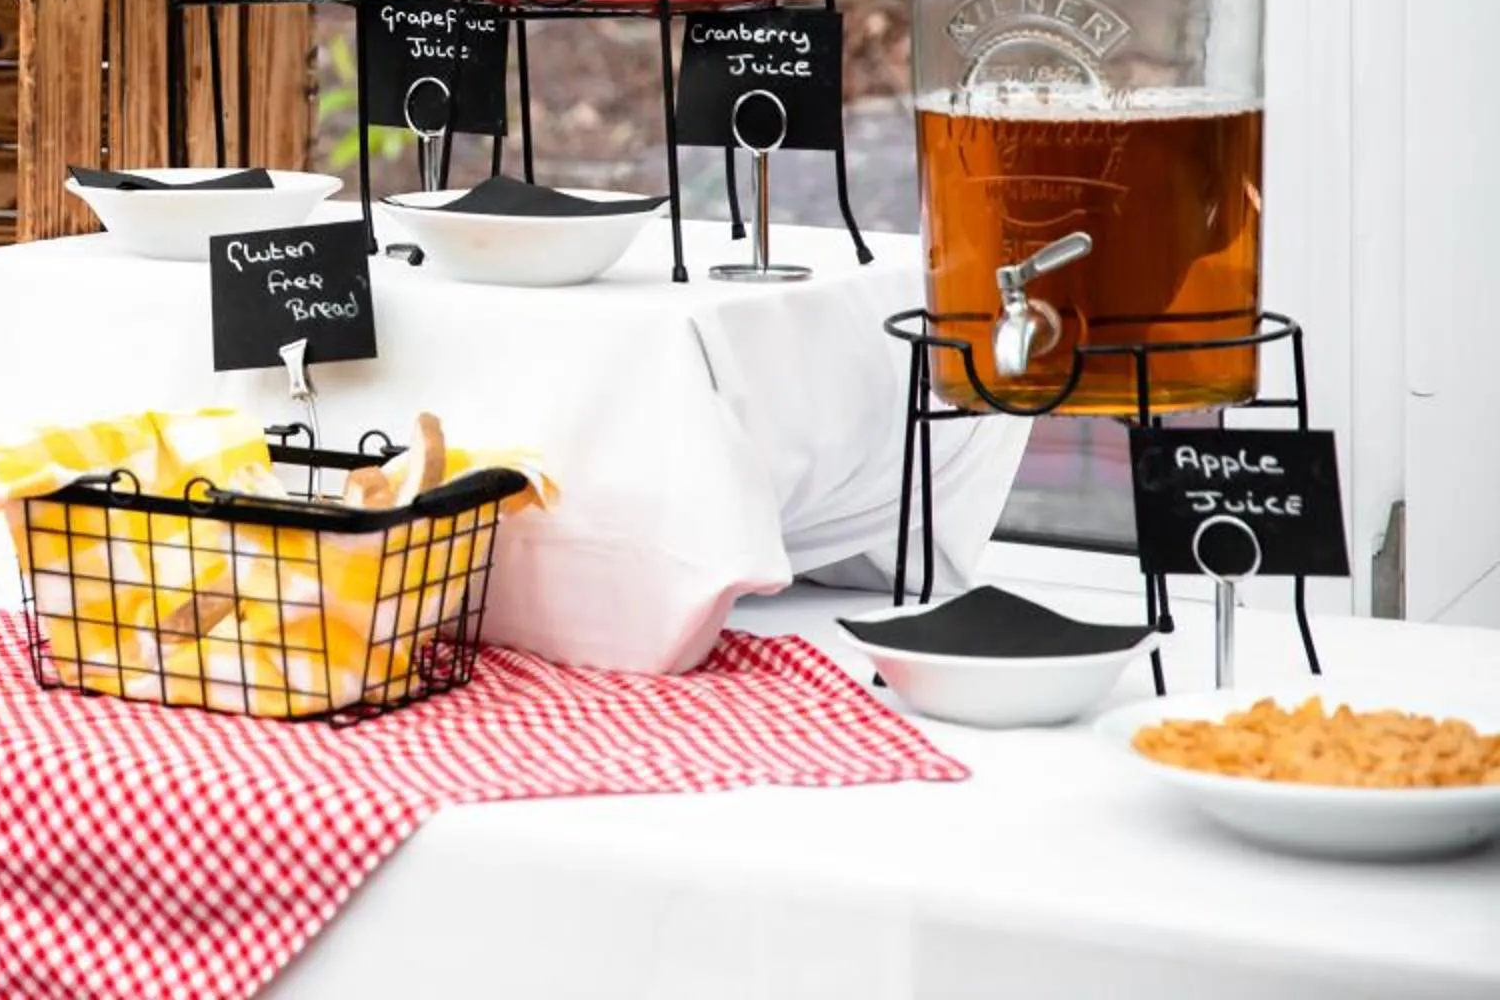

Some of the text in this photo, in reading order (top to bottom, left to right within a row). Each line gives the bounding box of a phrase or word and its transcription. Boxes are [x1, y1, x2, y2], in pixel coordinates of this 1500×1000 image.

[691, 23, 811, 53] Cranberry
[726, 54, 812, 76] Juice
[227, 241, 315, 272] Gluten
[285, 291, 359, 321] Bread
[1175, 445, 1285, 479] Apple
[1185, 490, 1302, 516] Juice
